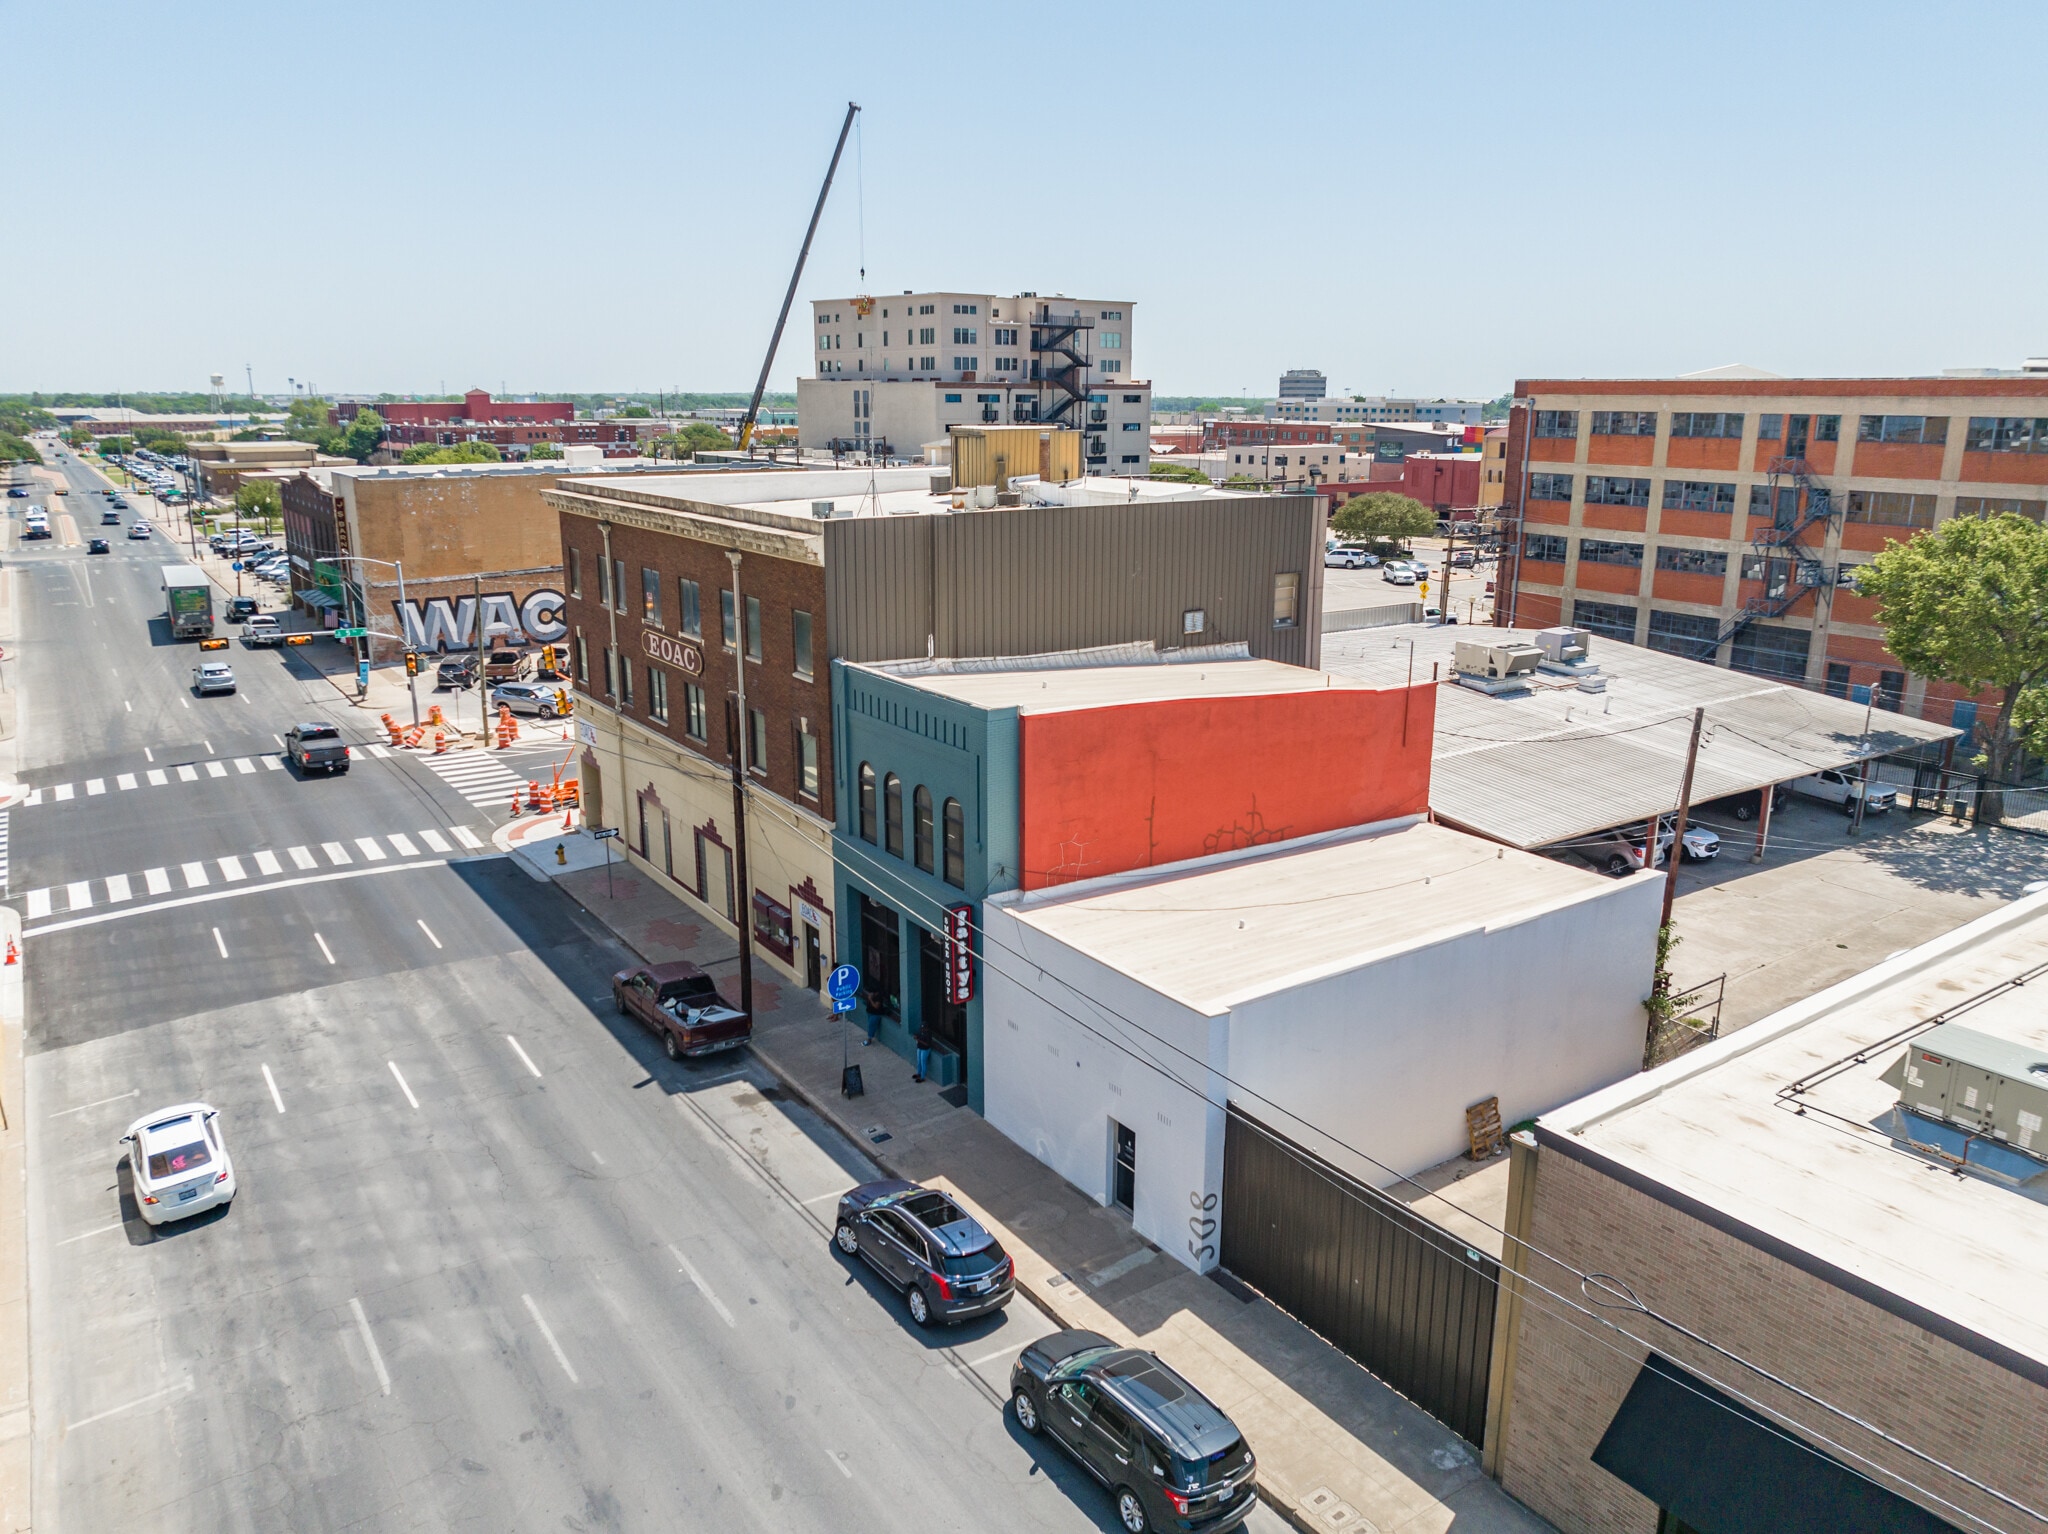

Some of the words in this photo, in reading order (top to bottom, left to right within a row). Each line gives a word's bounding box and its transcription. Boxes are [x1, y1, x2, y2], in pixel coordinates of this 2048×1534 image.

[648, 633, 695, 671] EOAC
[837, 967, 849, 986] P
[1188, 1190, 1218, 1262] 508
